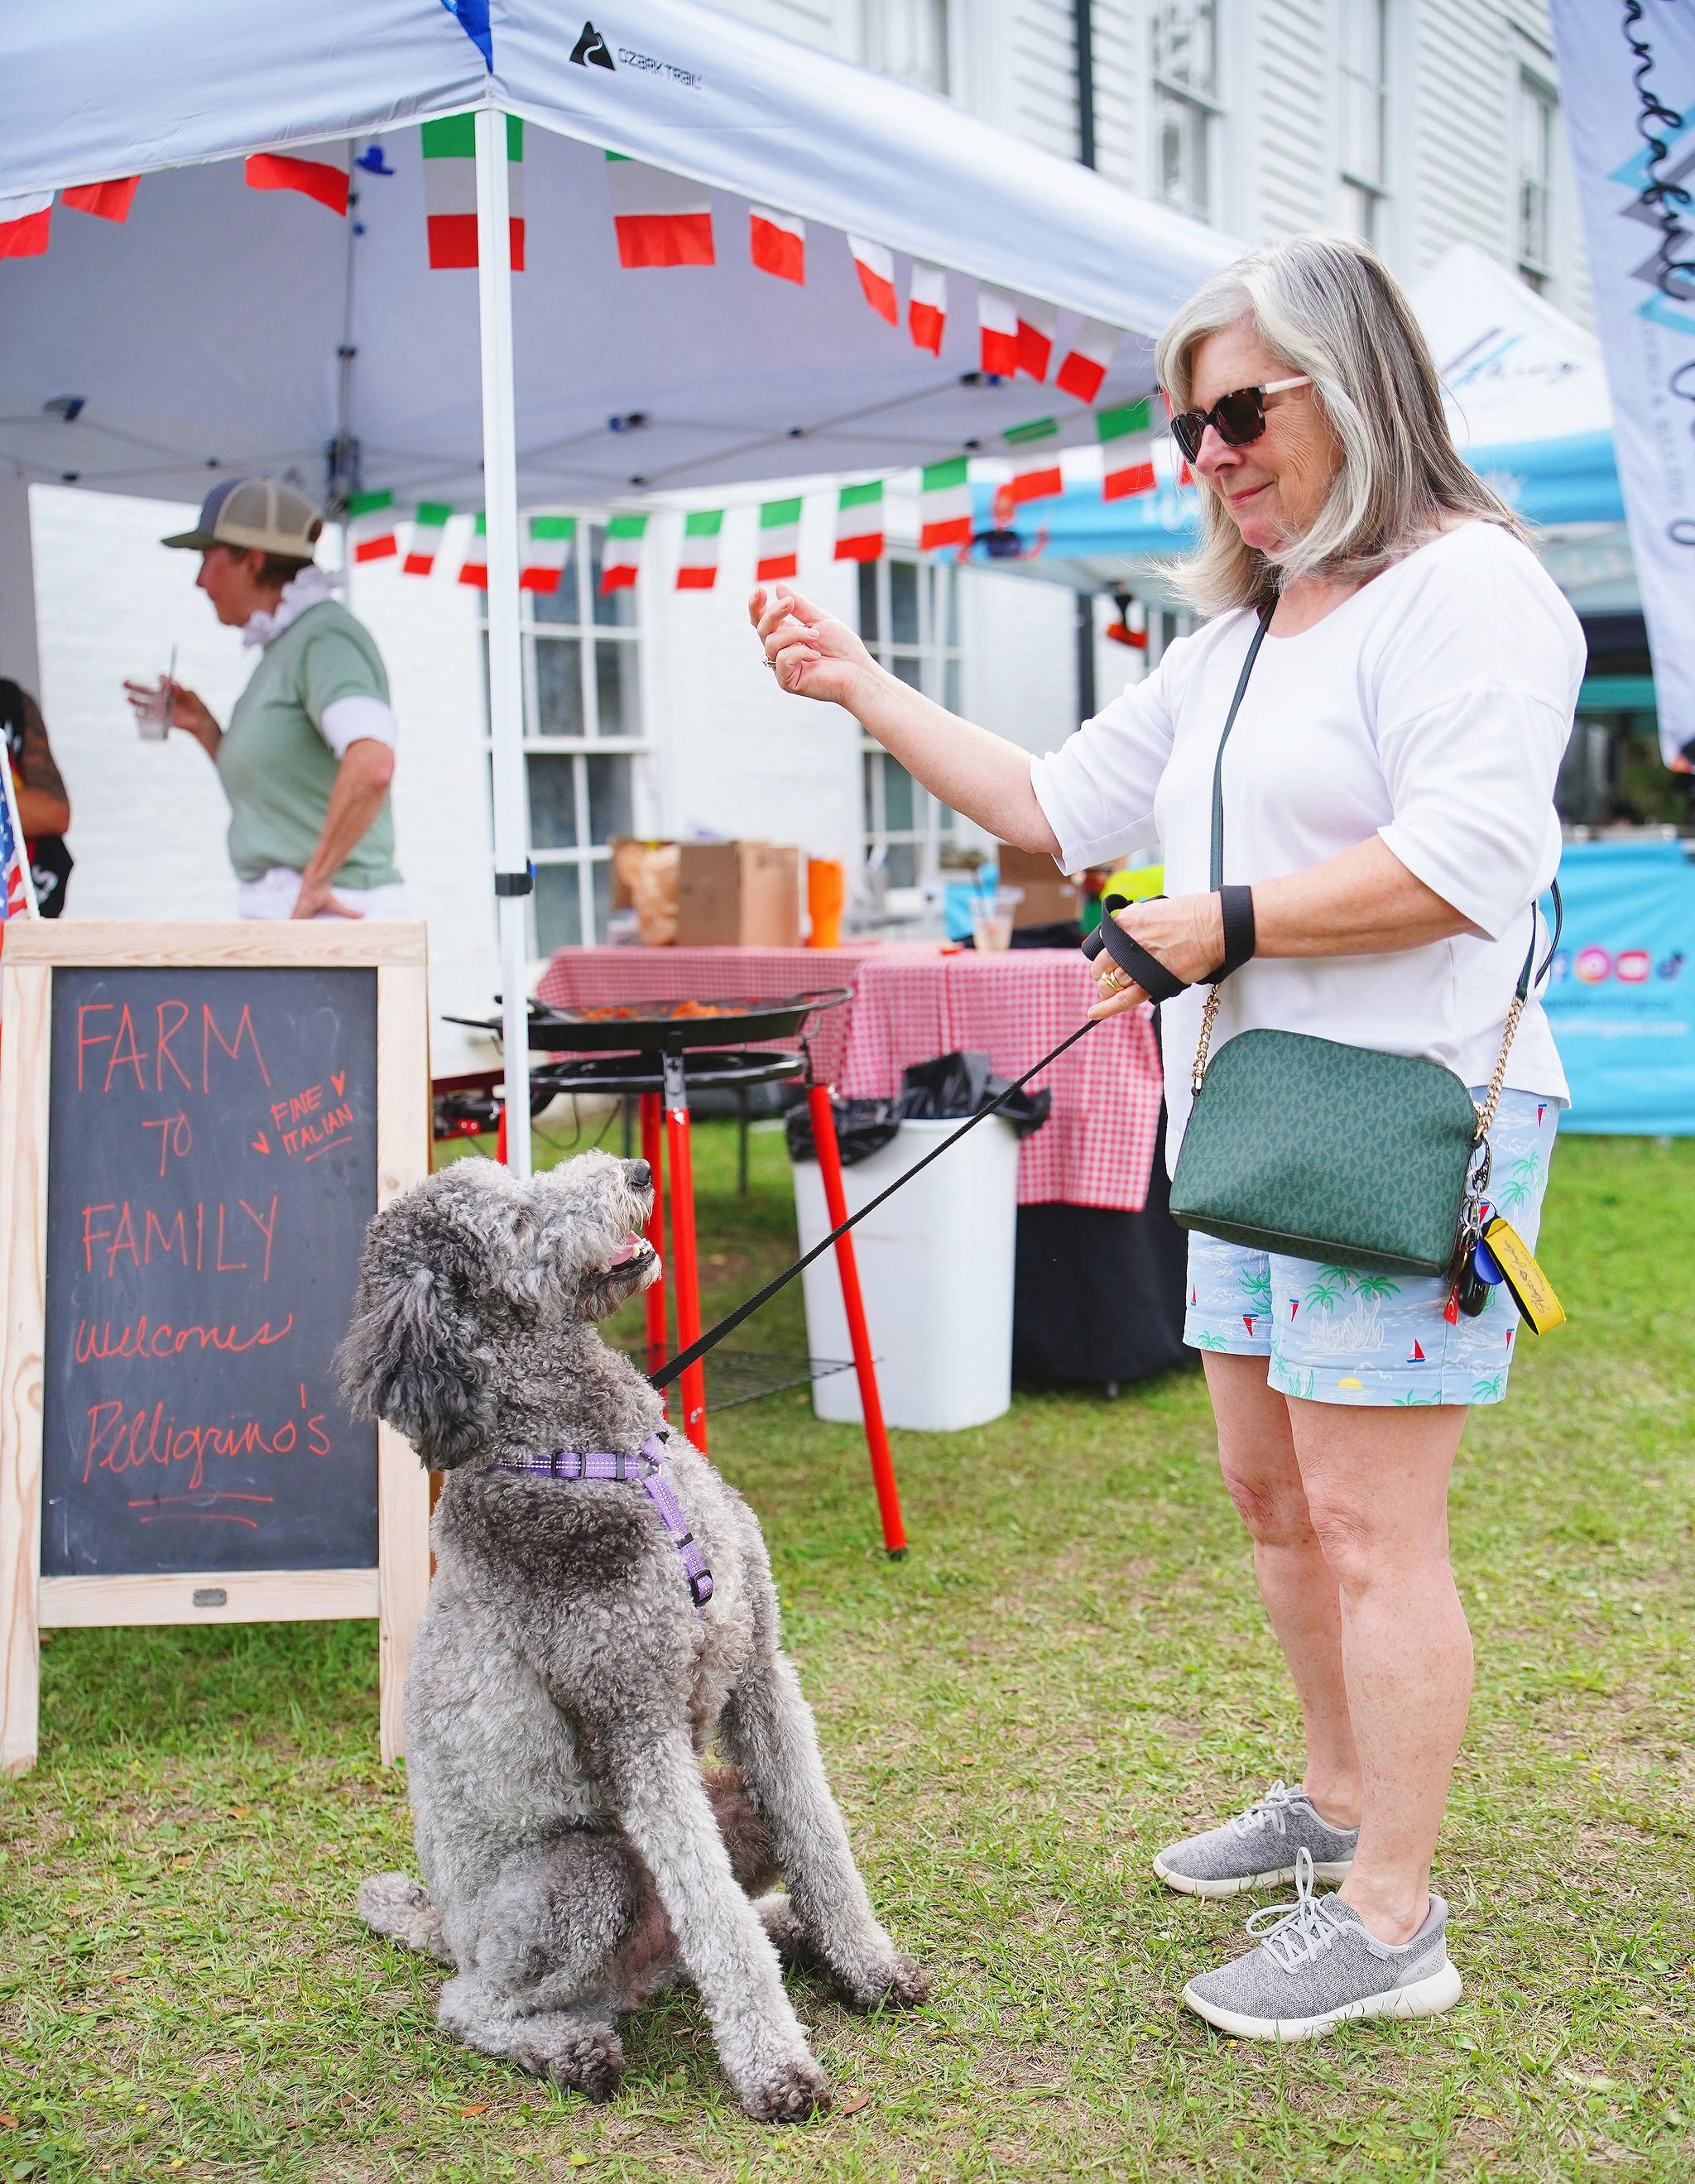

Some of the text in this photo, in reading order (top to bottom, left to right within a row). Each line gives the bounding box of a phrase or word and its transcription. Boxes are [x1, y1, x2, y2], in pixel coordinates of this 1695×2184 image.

[78, 1001, 271, 1092] FARM
[142, 1113, 193, 1176] TO
[270, 1085, 323, 1130] FINE
[282, 1102, 353, 1155] ITALIAN
[81, 1195, 278, 1283] FAMILY
[83, 1383, 330, 1489] Pelligrino's
